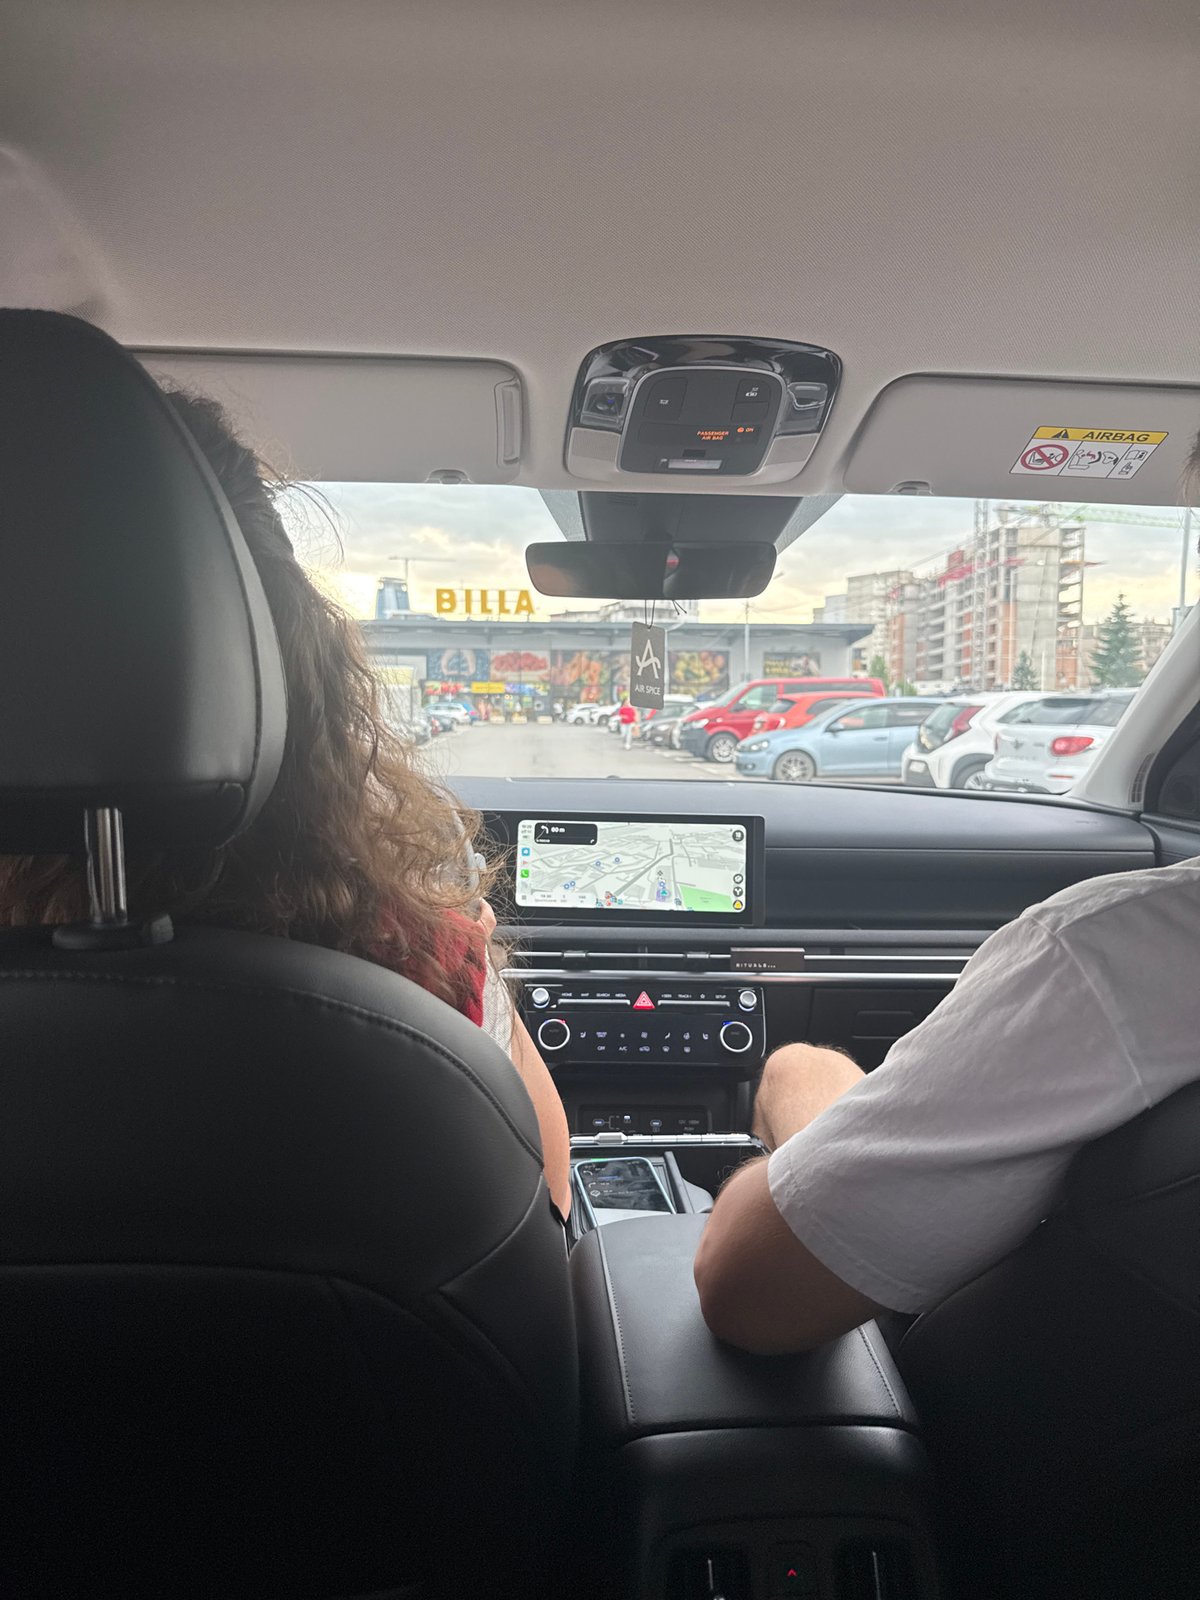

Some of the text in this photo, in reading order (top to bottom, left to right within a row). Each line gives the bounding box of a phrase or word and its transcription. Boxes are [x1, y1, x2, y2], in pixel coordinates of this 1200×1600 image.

[1082, 431, 1151, 443] AIRBAG
[436, 588, 535, 615] BILLA
[634, 683, 645, 693] AIR
